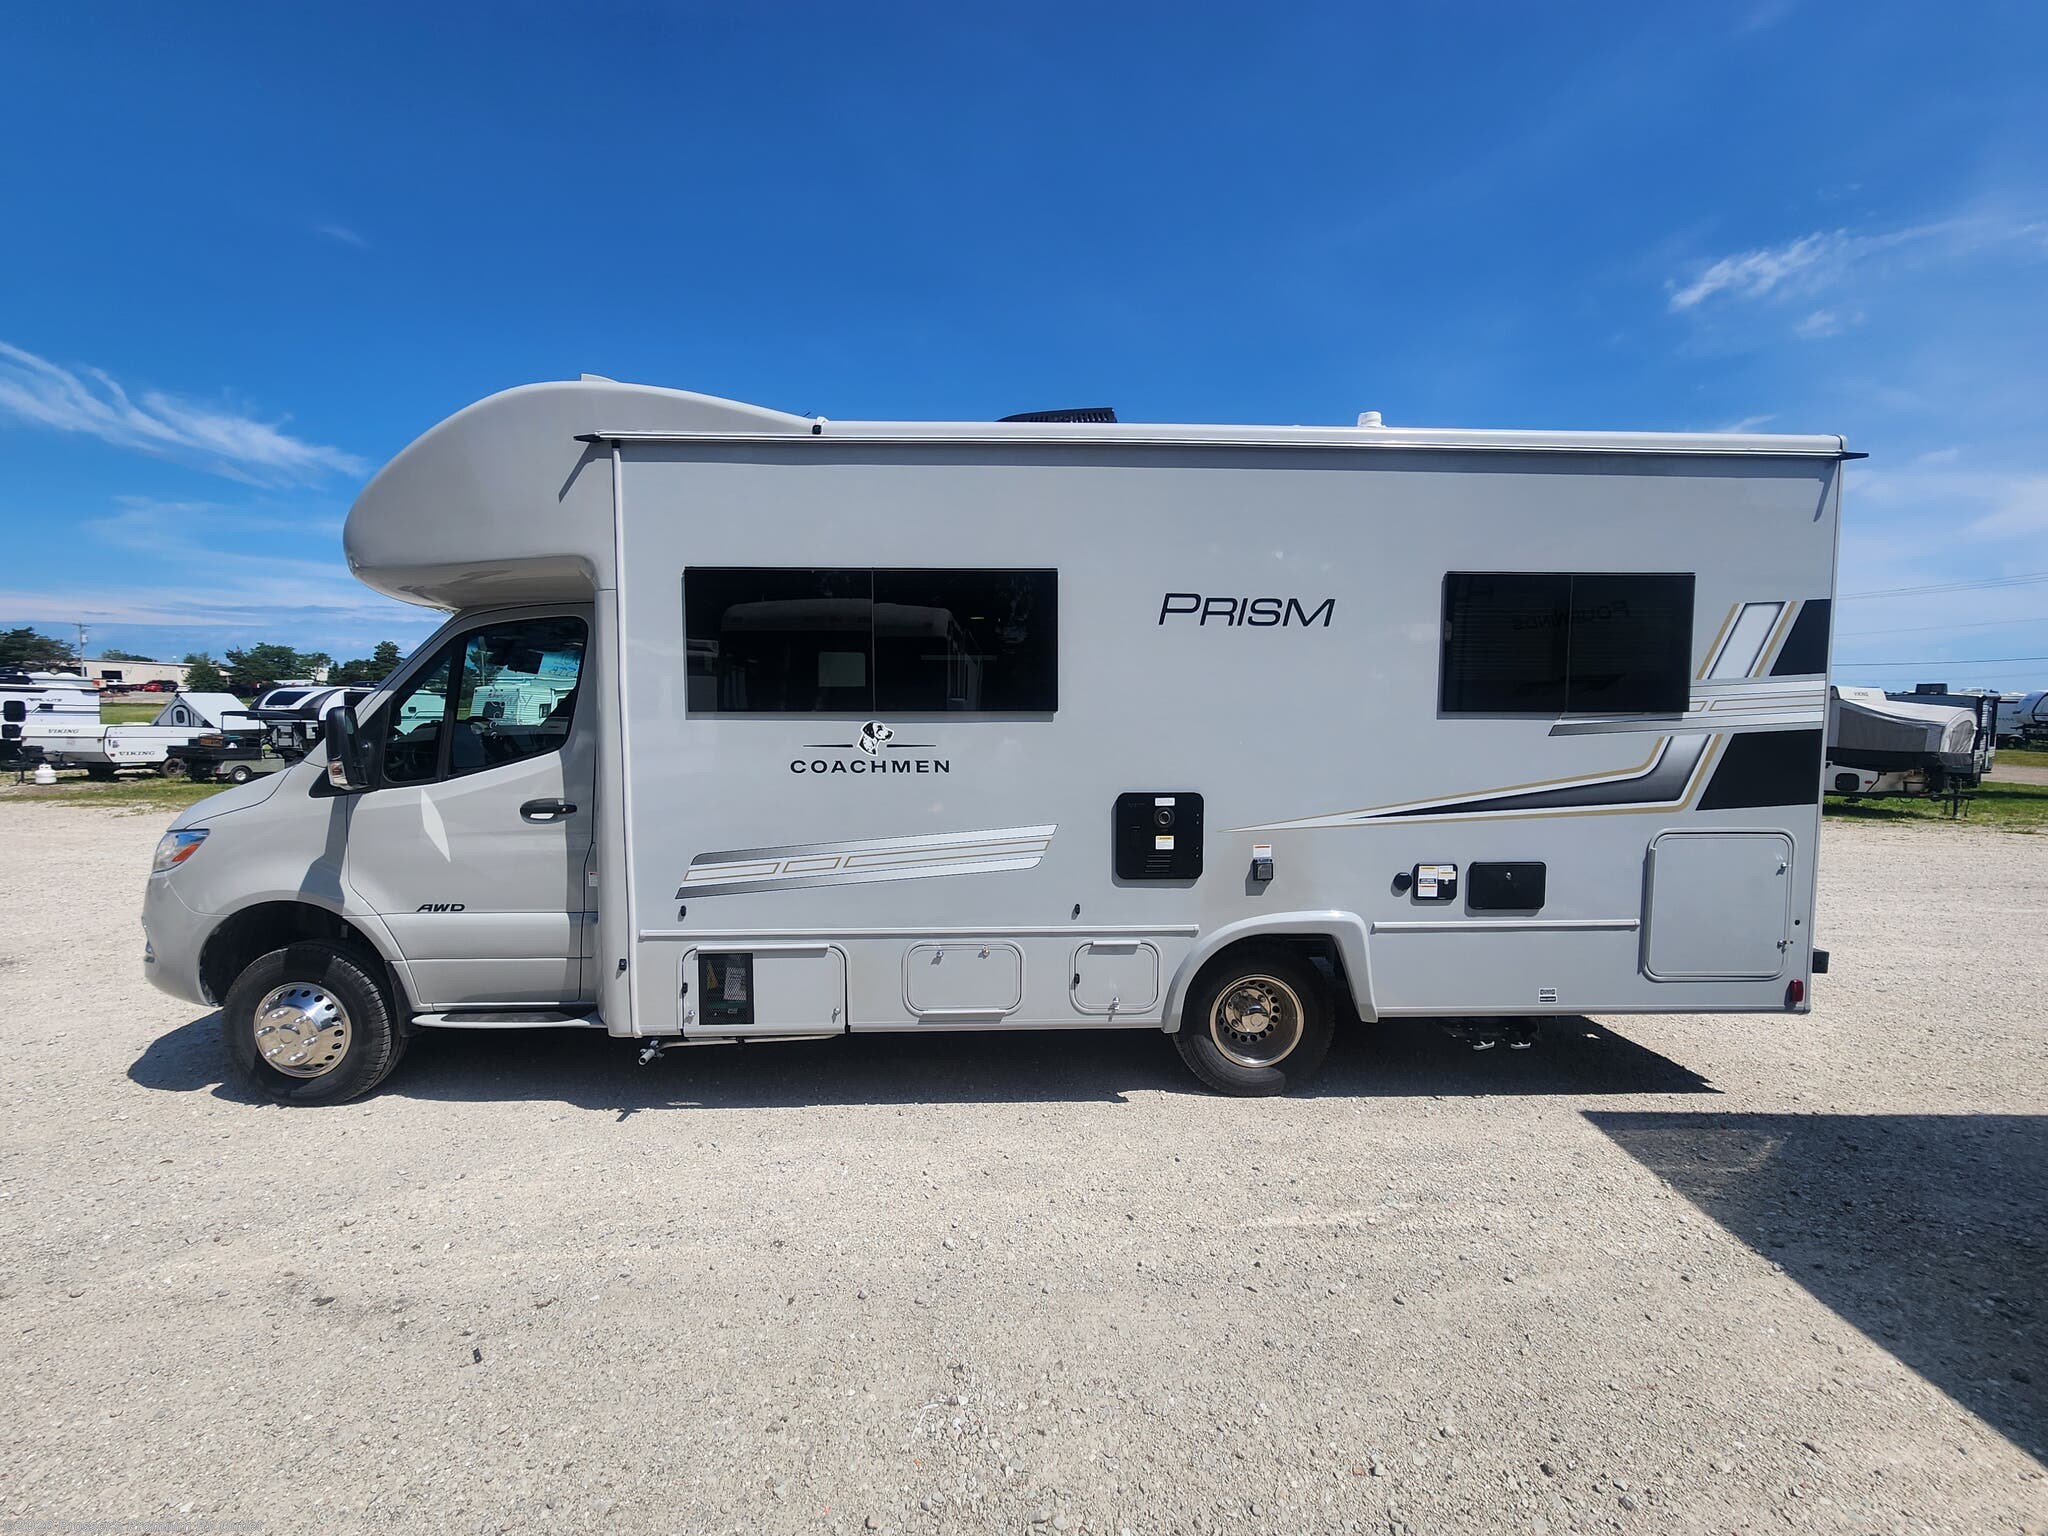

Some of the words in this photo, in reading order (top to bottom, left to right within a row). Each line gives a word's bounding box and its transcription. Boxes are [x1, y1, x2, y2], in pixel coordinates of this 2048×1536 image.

[1158, 593, 1336, 627] PRISM
[790, 760, 950, 774] COACHMEN
[416, 903, 466, 912] AWD
